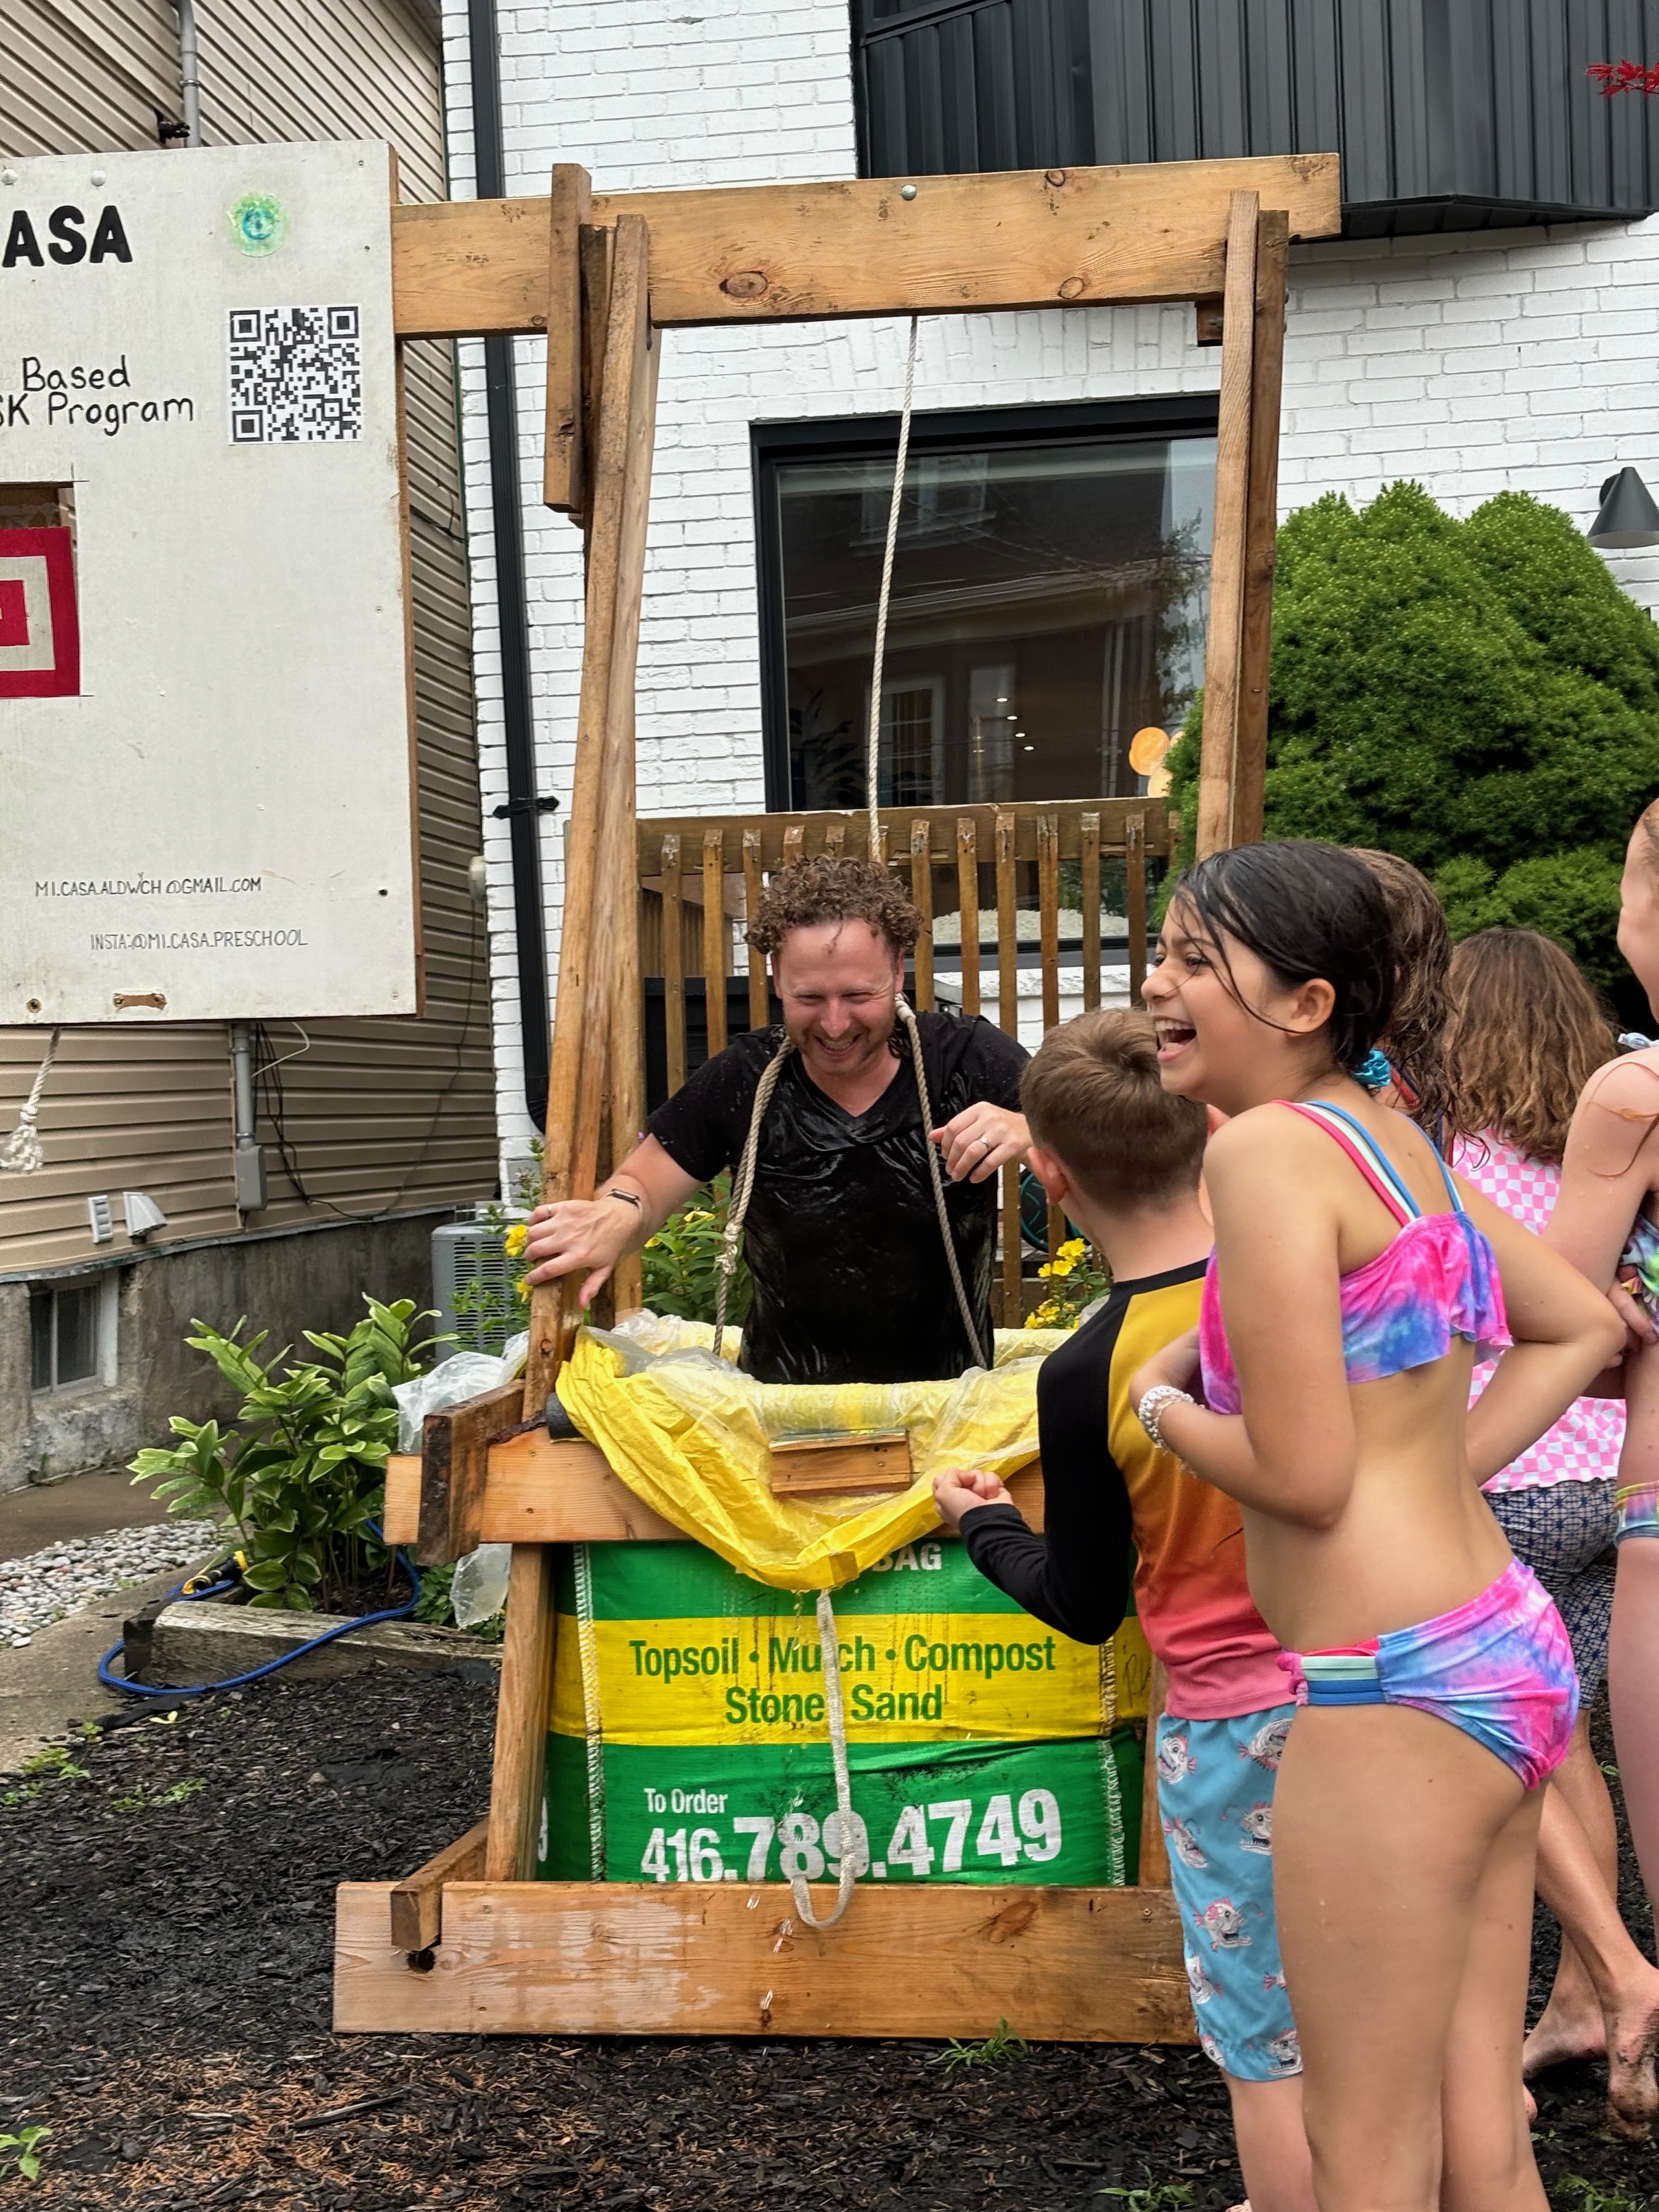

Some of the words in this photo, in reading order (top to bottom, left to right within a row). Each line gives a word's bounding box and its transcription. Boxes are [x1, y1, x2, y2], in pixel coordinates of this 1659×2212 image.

[2, 205, 132, 267] ASA
[22, 355, 131, 392] Based
[0, 393, 30, 427] K
[48, 391, 193, 437] Program
[629, 1637, 740, 1684] Topsoil
[769, 1635, 876, 1673] Much
[905, 1634, 1056, 1679] Compost
[725, 1686, 825, 1724] Stone
[850, 1684, 943, 1721] Sand
[644, 1788, 667, 1813] To
[670, 1788, 729, 1814] Order
[641, 1788, 1062, 1882] 416.789.4749
